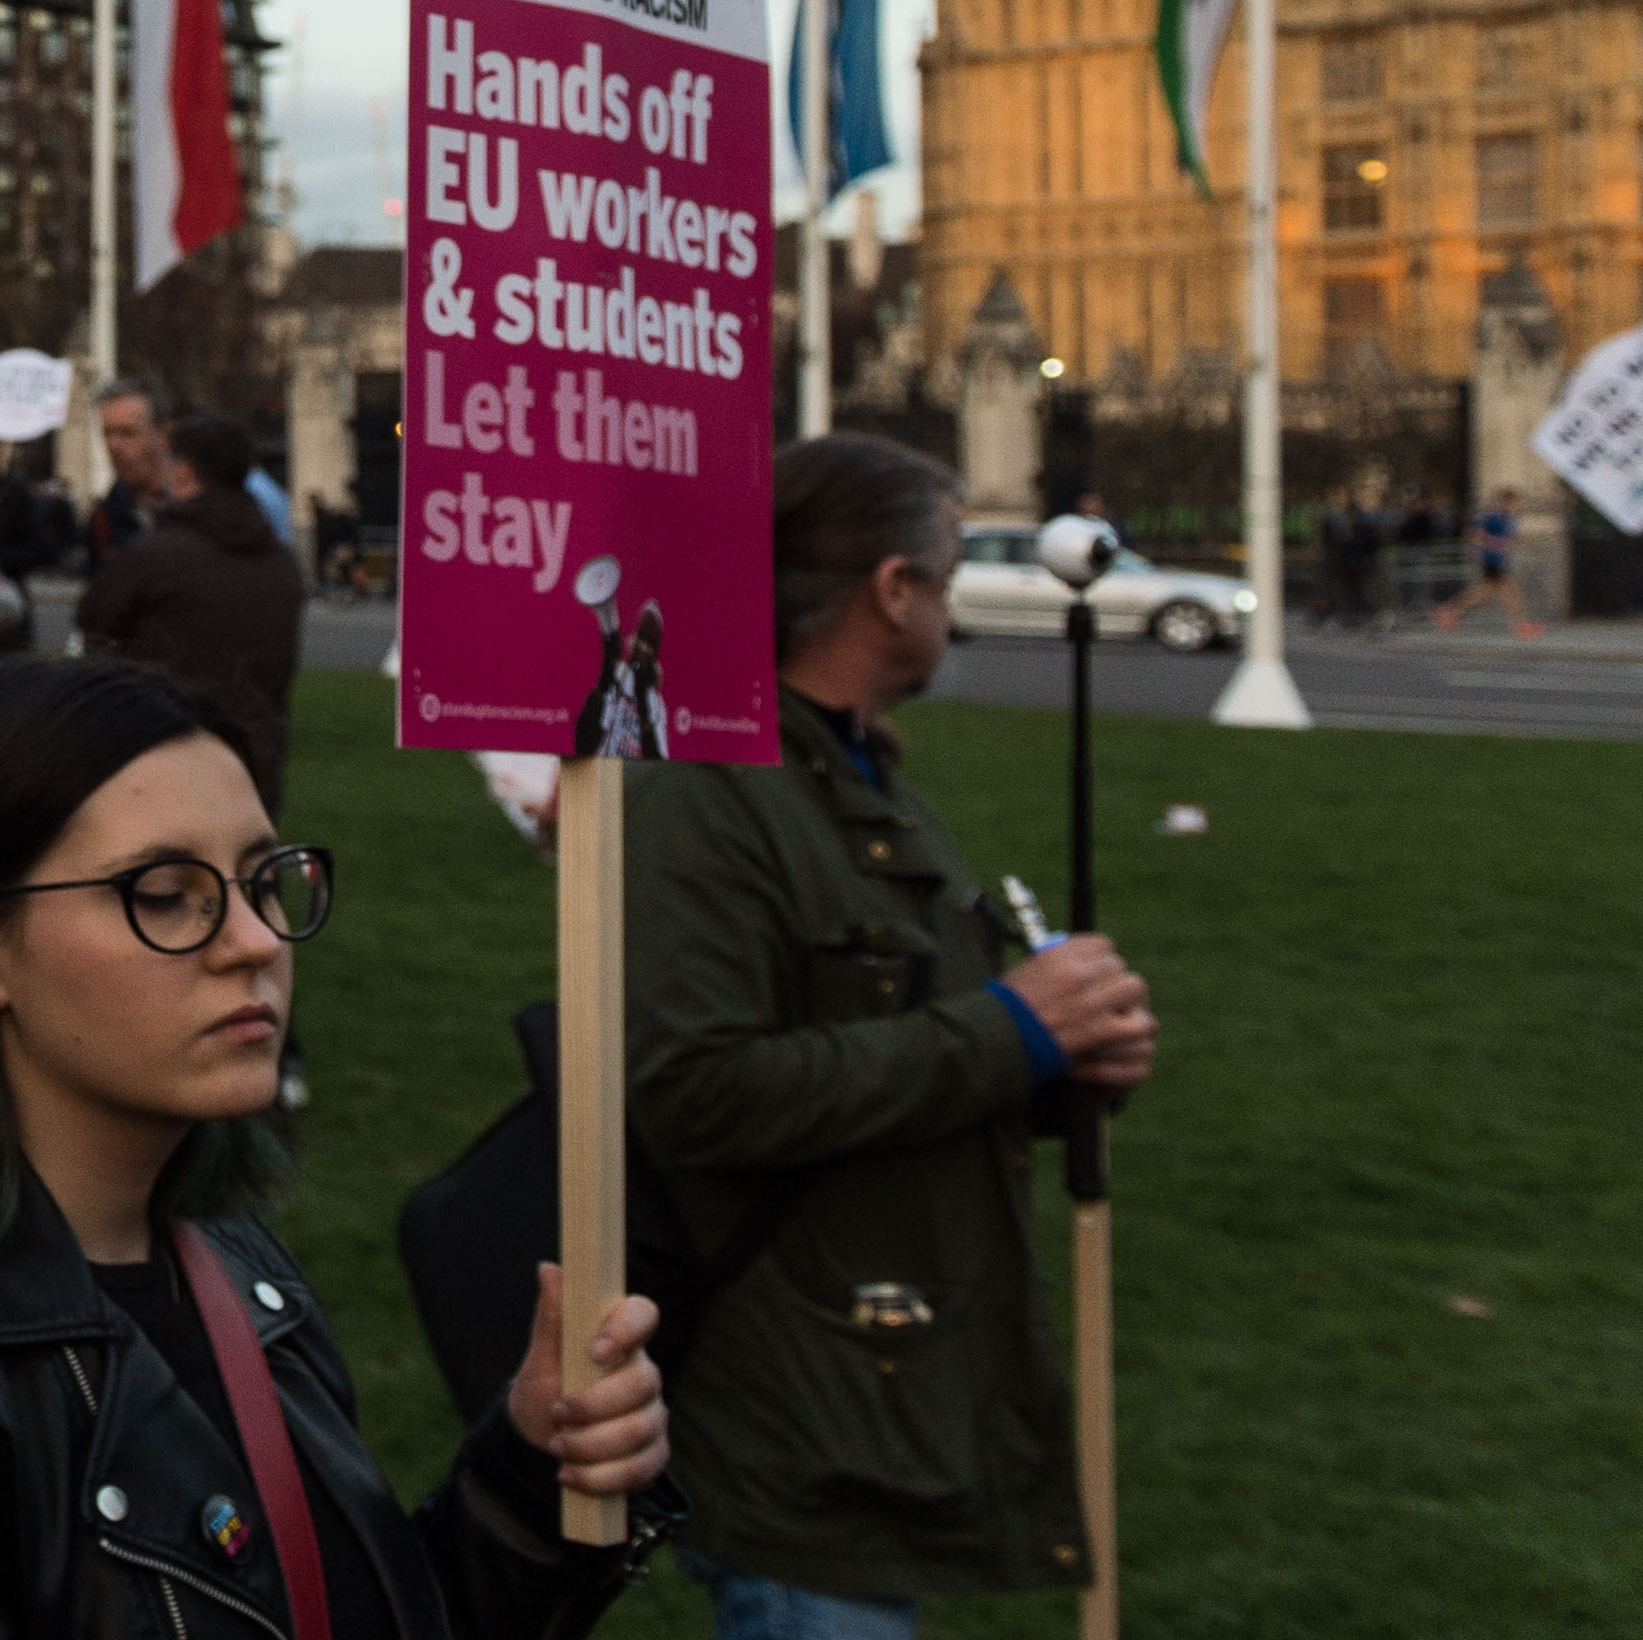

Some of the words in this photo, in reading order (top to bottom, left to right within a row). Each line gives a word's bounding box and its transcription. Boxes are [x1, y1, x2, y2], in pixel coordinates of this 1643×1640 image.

[428, 14, 630, 141] Hands
[641, 70, 712, 163] off
[427, 126, 518, 231] EU
[539, 168, 756, 277] workers
[424, 238, 475, 338] &
[495, 258, 742, 378] students
[427, 351, 533, 455] Let
[554, 370, 696, 474] them
[424, 473, 571, 592] stay
